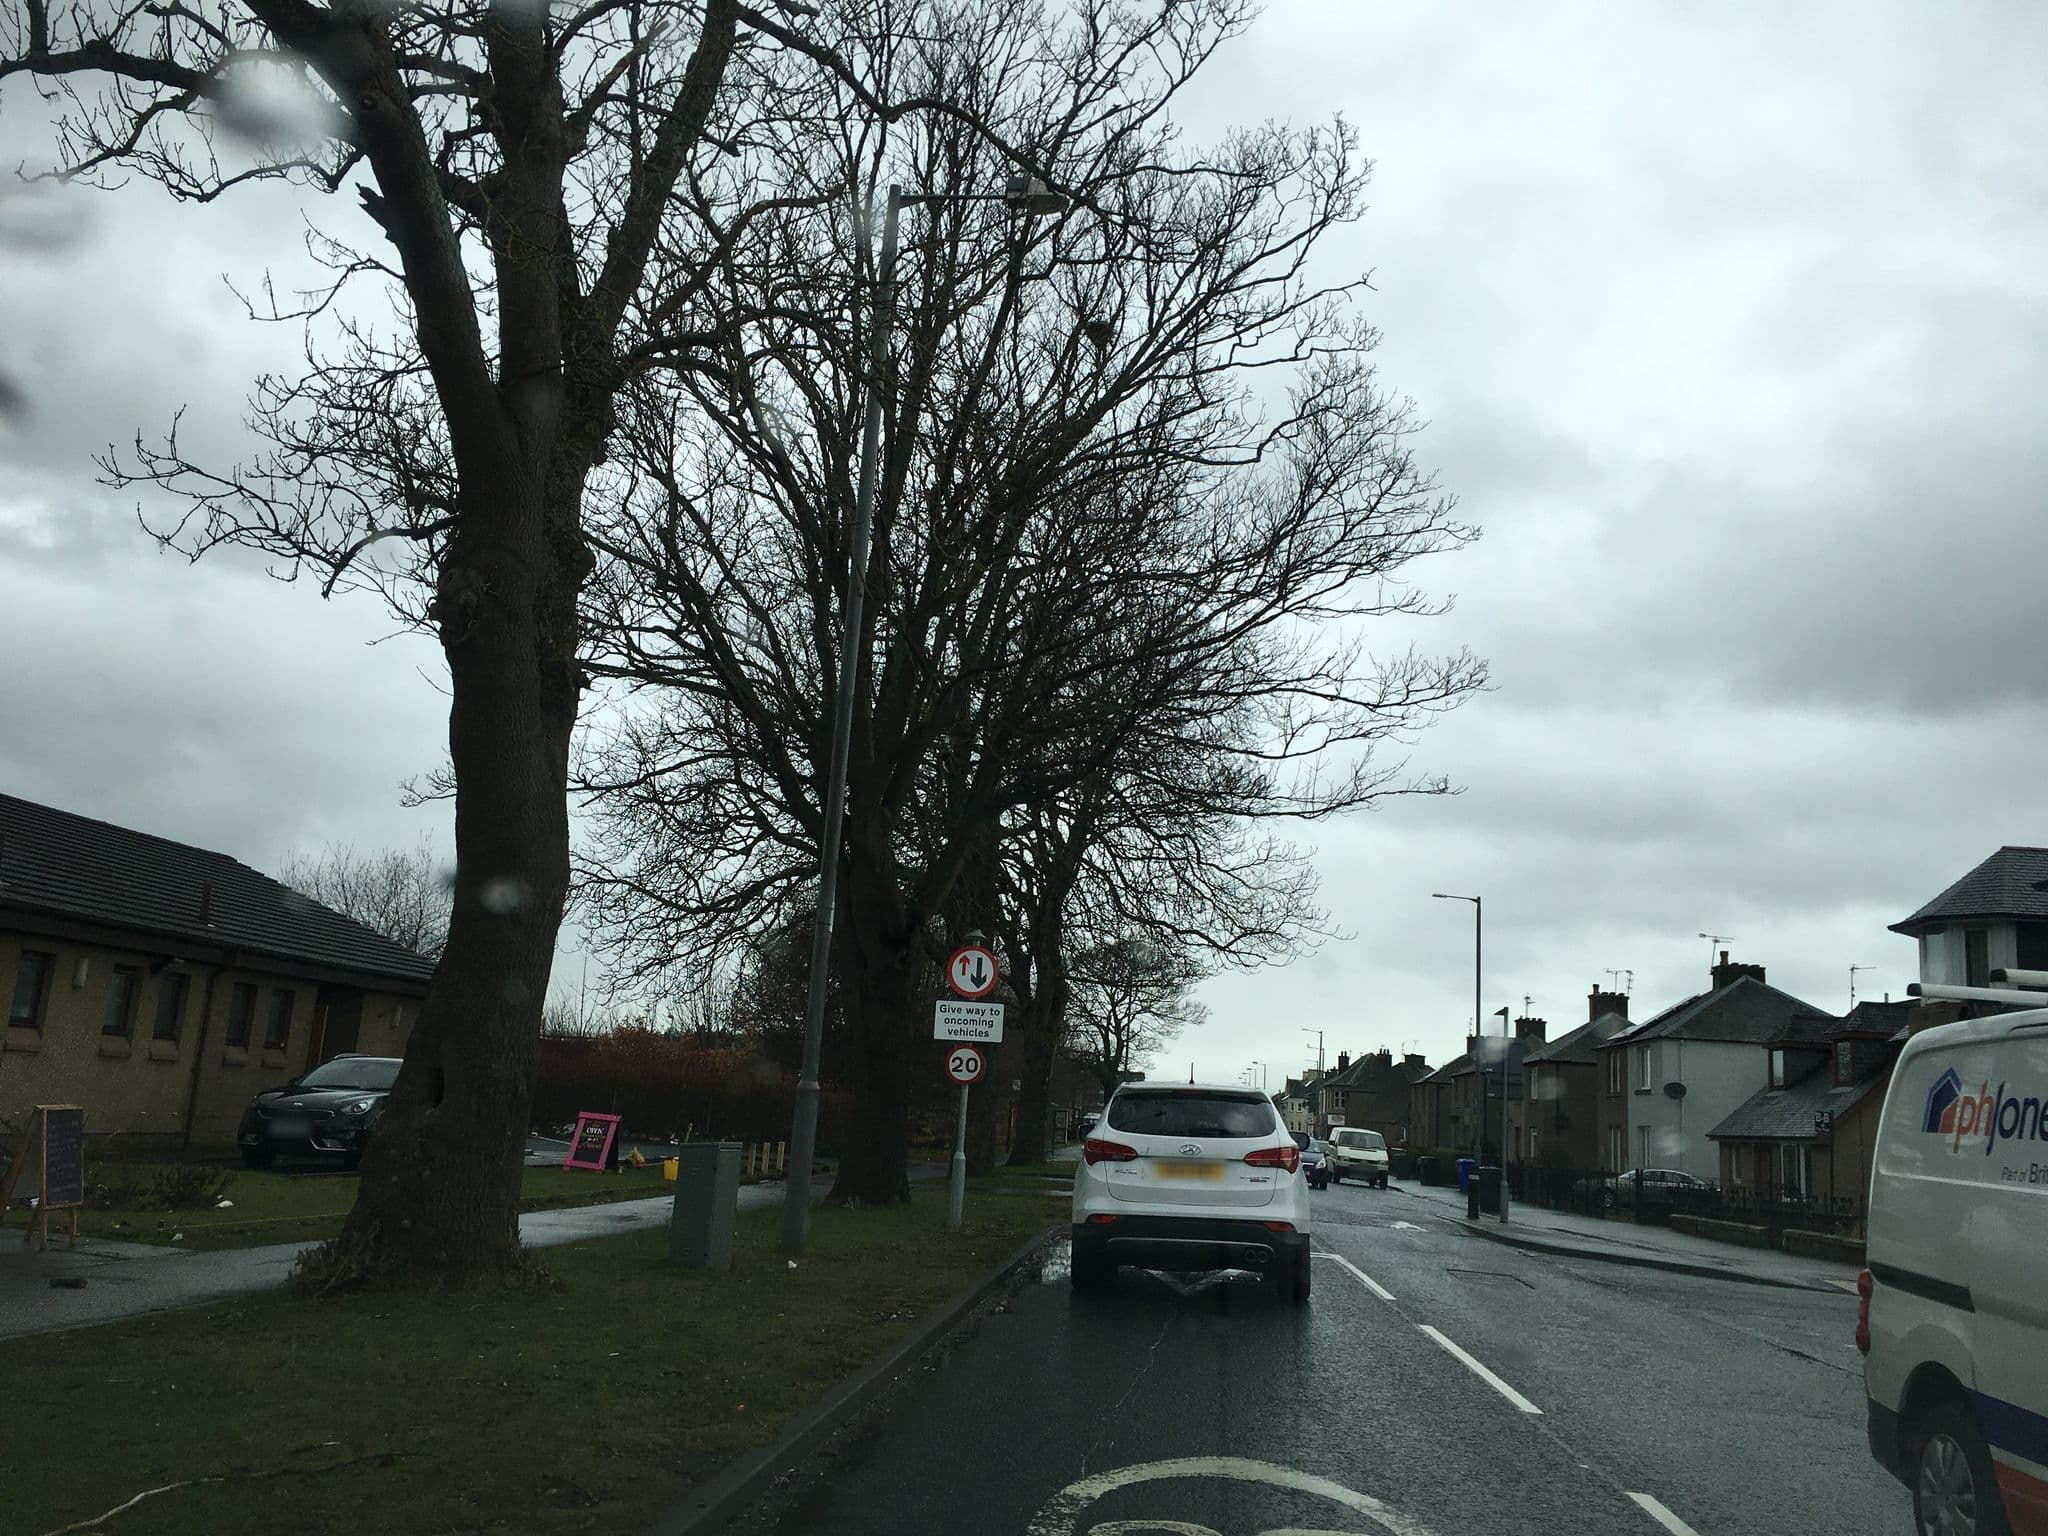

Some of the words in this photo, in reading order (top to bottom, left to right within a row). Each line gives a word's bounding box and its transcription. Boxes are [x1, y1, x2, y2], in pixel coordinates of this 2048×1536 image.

[940, 1004, 962, 1014] Give
[966, 1007, 986, 1016] way
[990, 1007, 1000, 1016] to
[944, 1017, 993, 1028] oncoming
[948, 1027, 989, 1037] vehicles
[951, 1056, 978, 1073] 20
